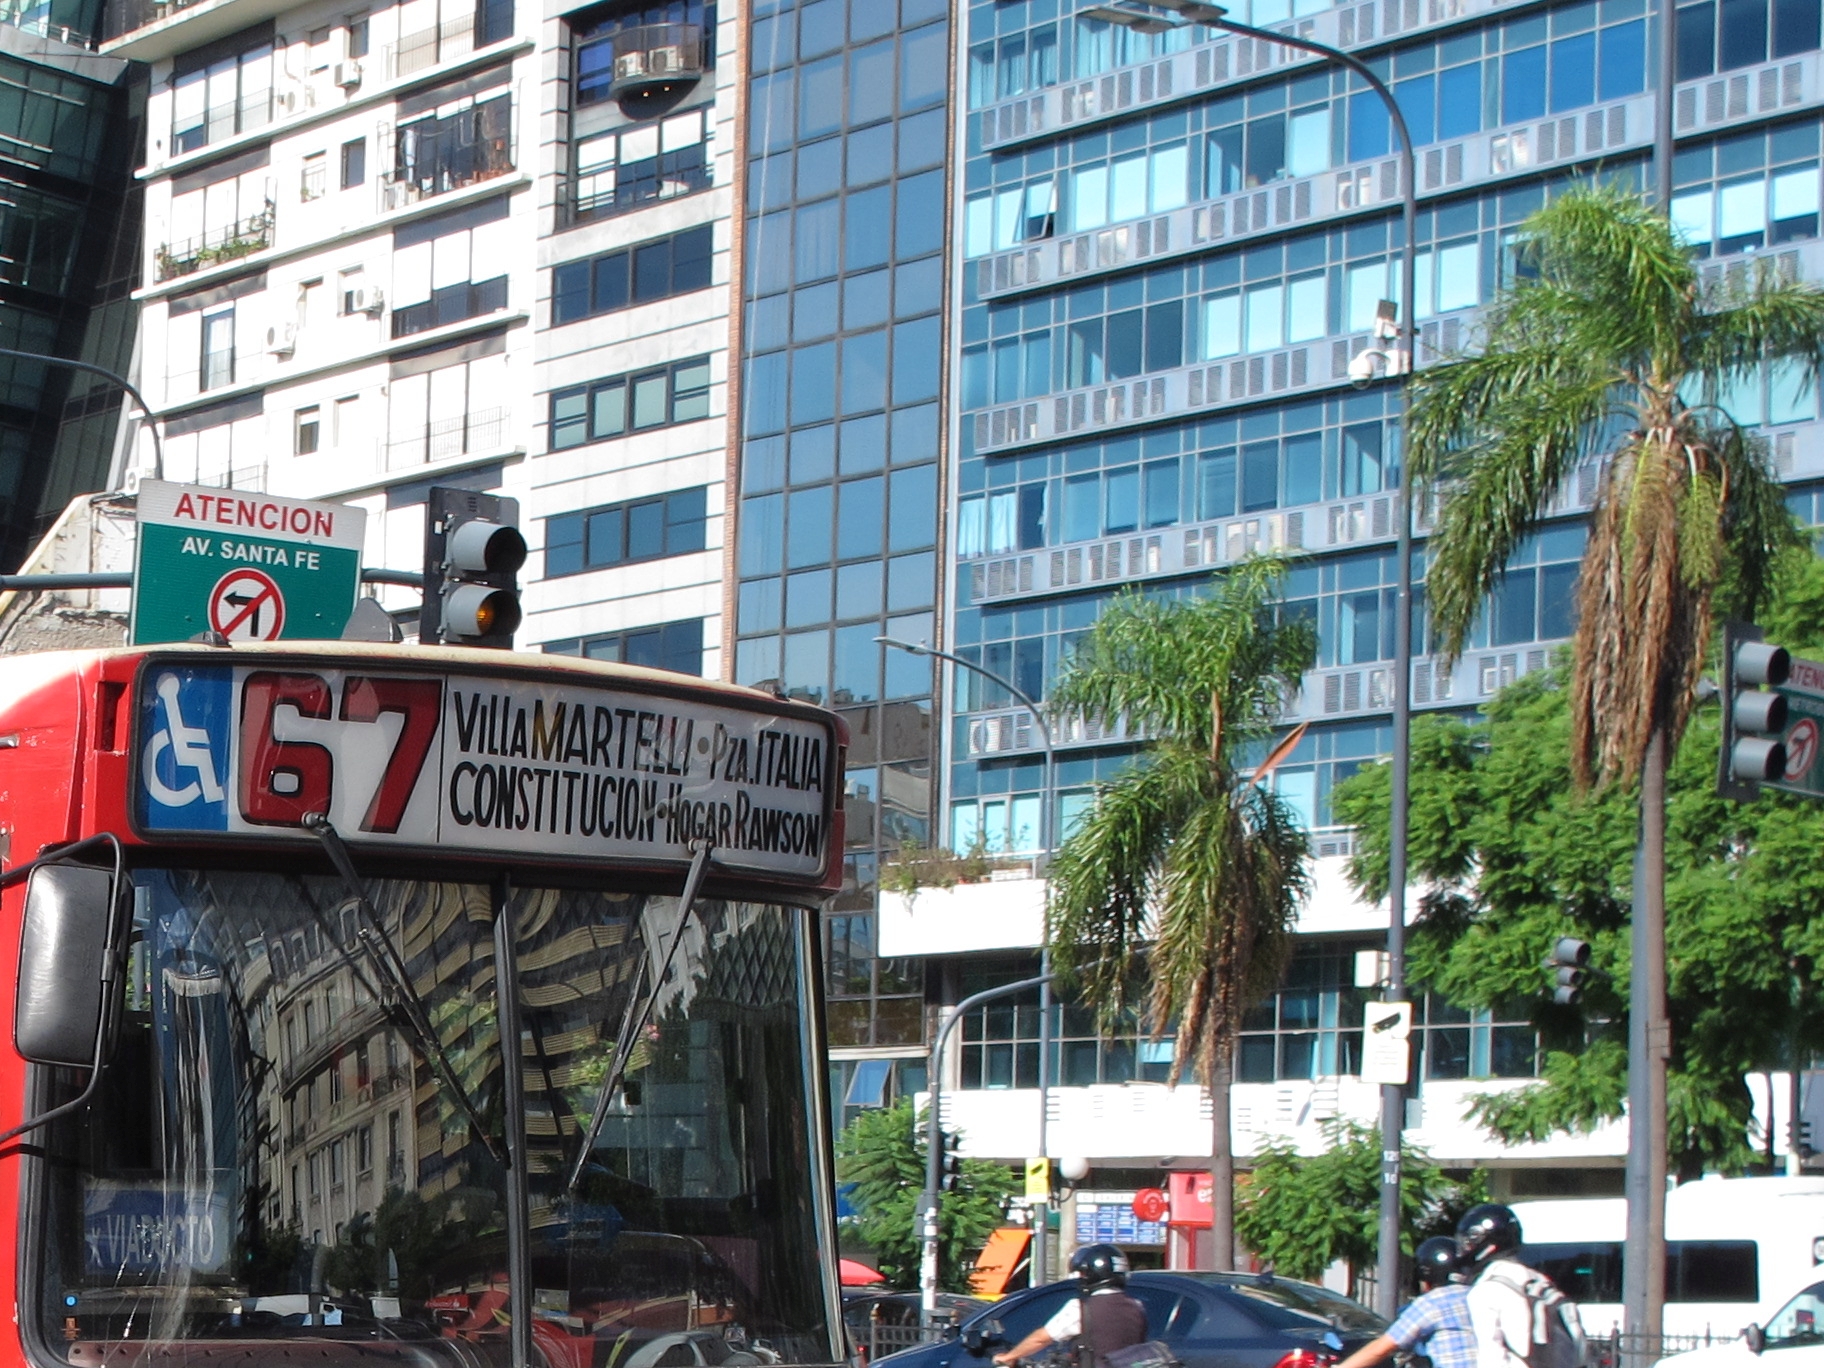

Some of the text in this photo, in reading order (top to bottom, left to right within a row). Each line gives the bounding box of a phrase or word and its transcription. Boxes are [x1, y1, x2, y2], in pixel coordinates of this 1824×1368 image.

[174, 493, 334, 537] ATENCION
[181, 537, 320, 571] AV. SANTA FE
[238, 670, 443, 834] 67
[531, 699, 694, 776] MARTELLI
[755, 730, 822, 793] ITALIA
[450, 761, 658, 843] CONSTITUCION
[734, 790, 820, 858] RAWSON
